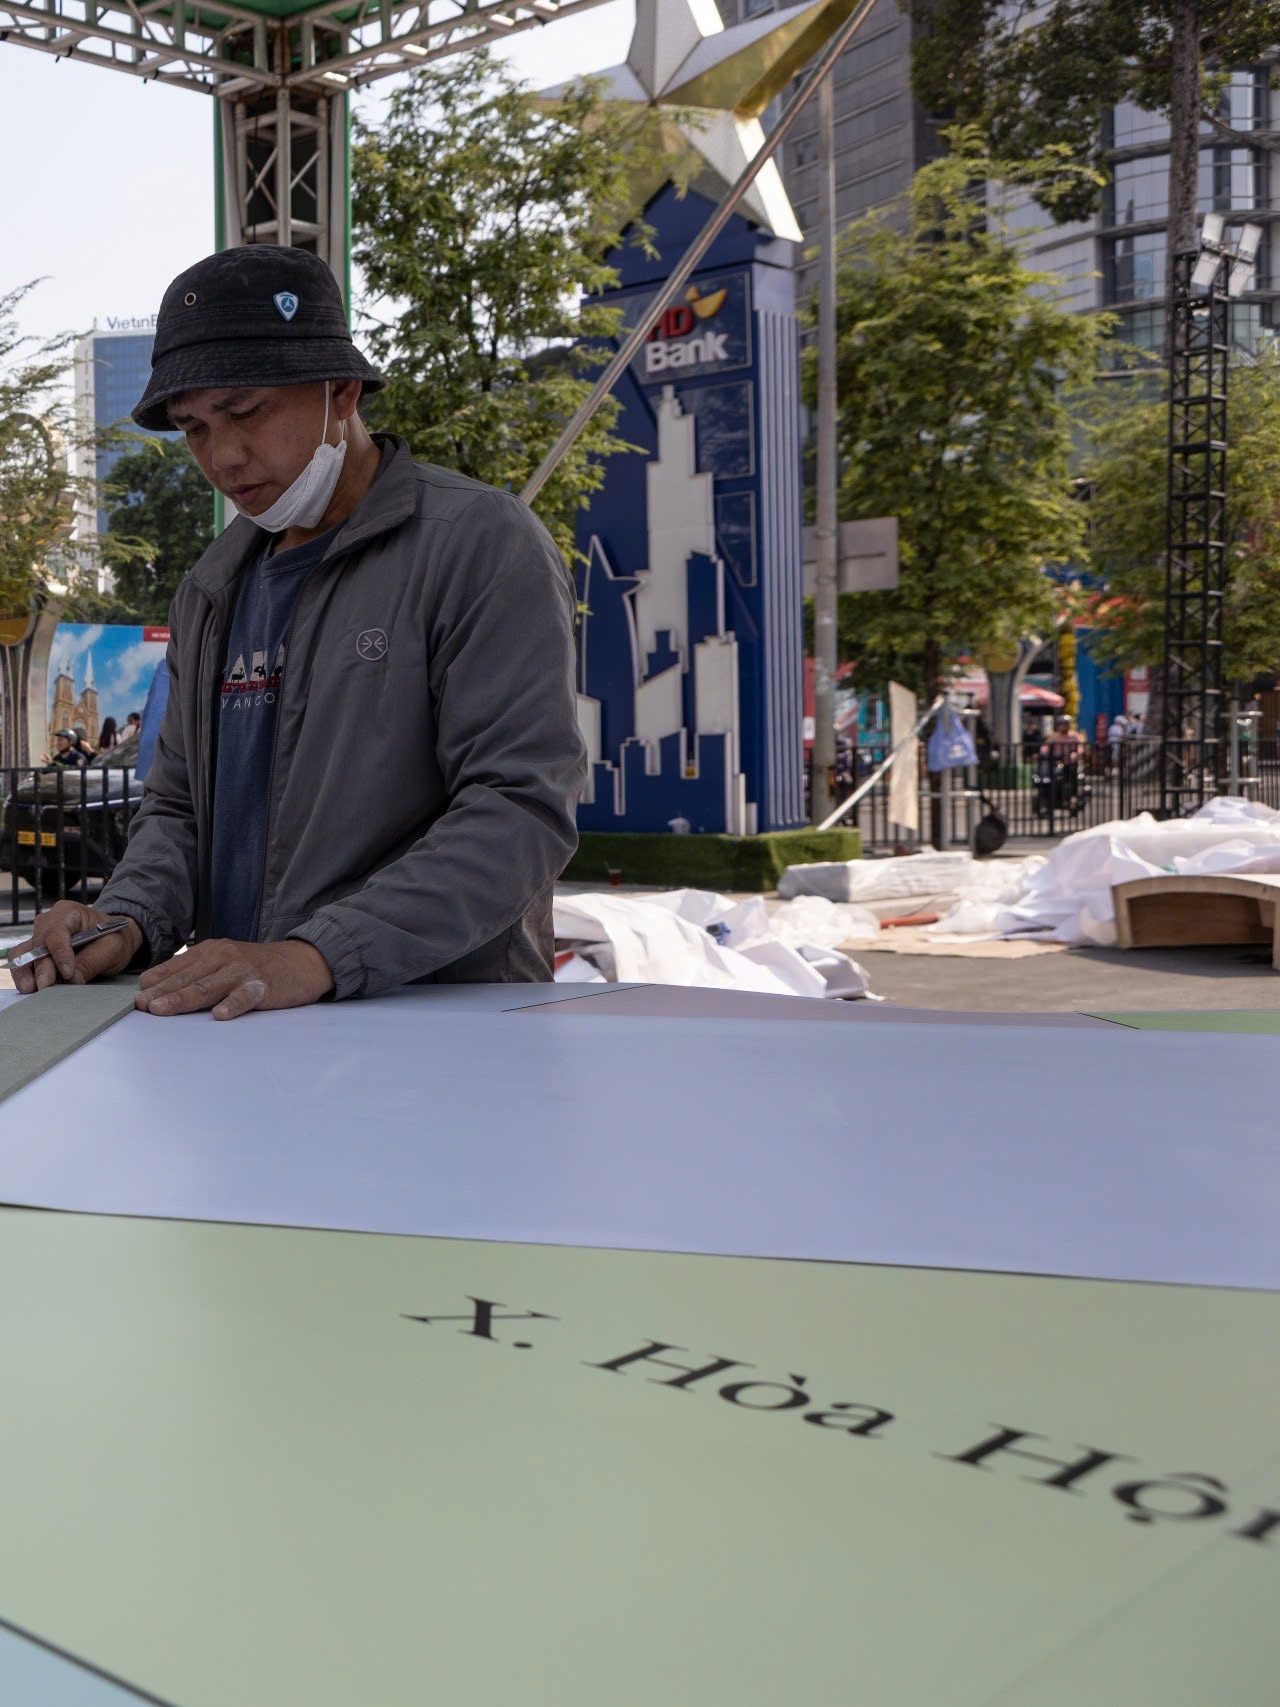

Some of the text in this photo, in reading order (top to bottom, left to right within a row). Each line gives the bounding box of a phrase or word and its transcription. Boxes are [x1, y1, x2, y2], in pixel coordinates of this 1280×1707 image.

[646, 331, 729, 372] Bank
[399, 1295, 561, 1349] X.
[580, 1337, 895, 1438] Hòa
